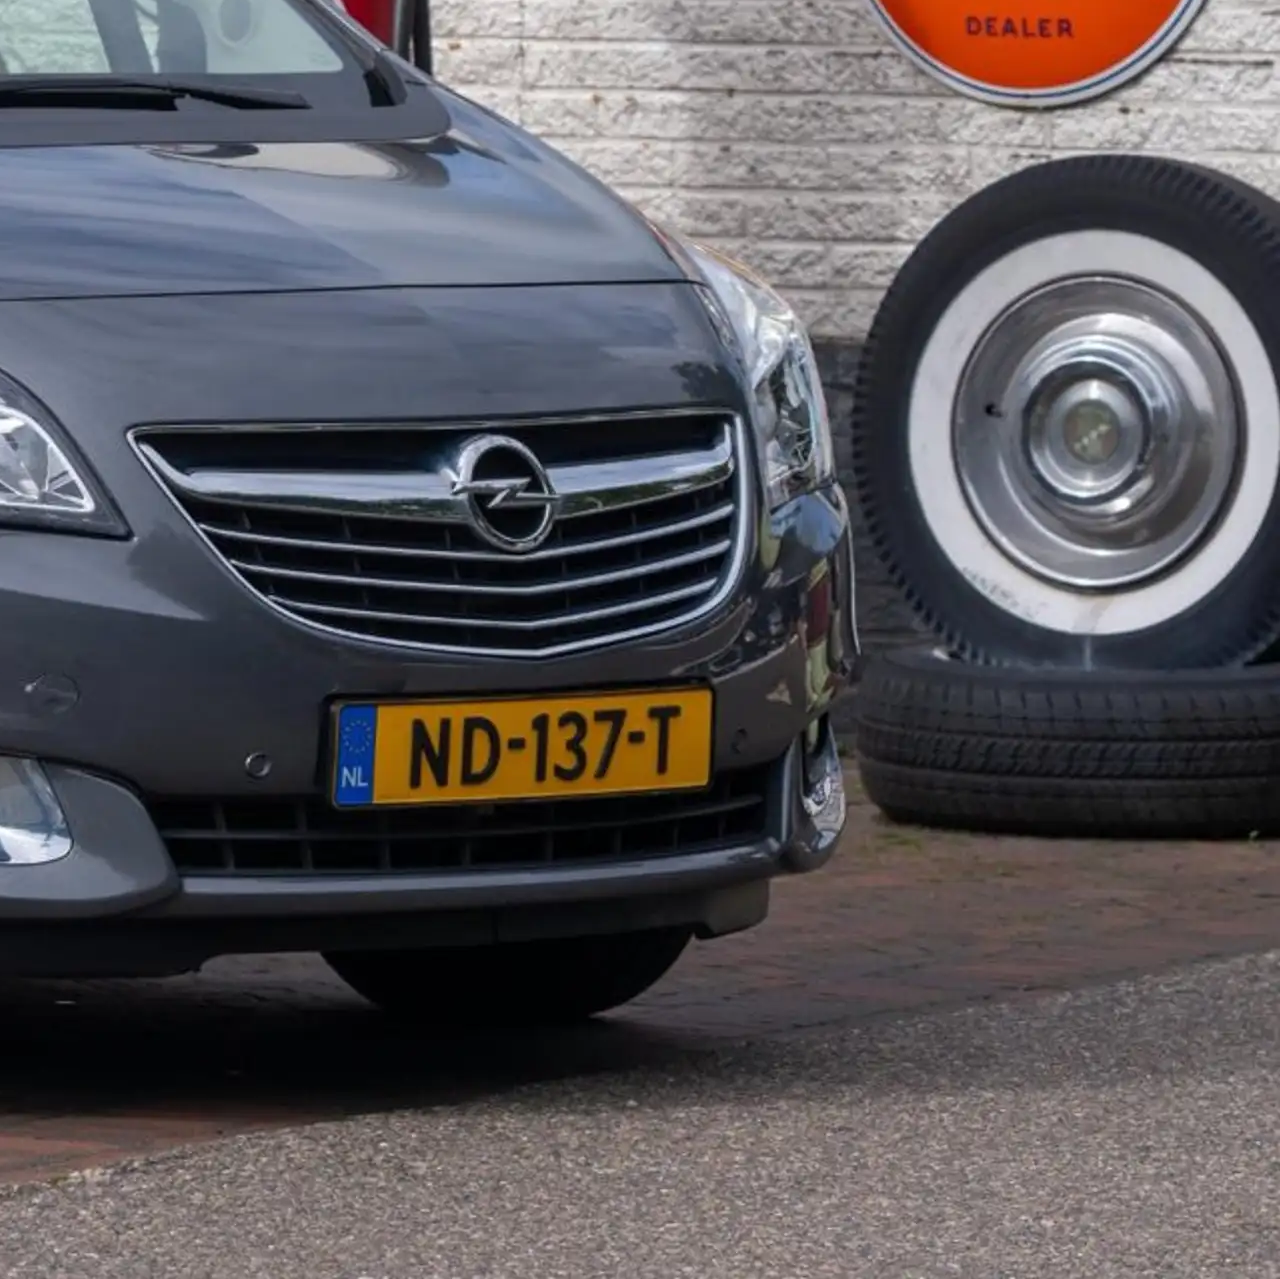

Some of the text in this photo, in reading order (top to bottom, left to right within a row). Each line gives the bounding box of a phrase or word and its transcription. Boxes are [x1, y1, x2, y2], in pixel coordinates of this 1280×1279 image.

[966, 16, 1074, 39] DEALER
[409, 705, 681, 789] ND-137-T
[341, 766, 369, 788] NL
